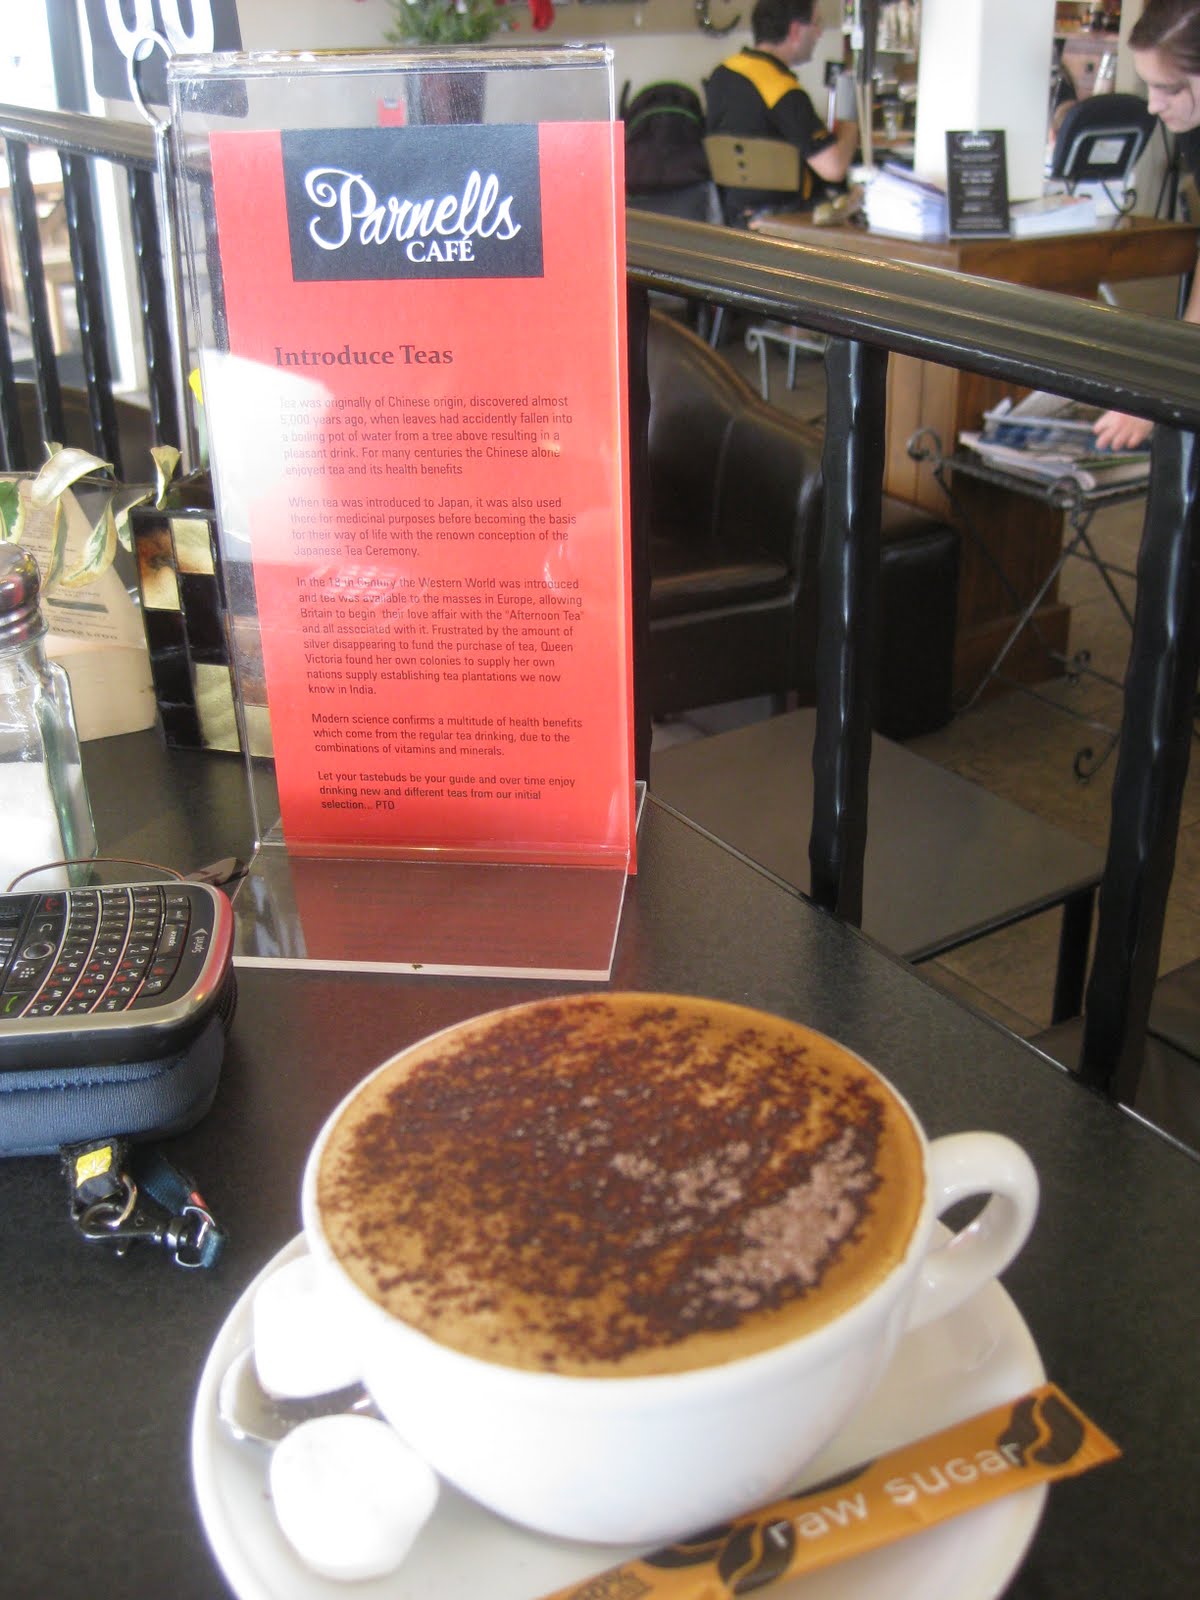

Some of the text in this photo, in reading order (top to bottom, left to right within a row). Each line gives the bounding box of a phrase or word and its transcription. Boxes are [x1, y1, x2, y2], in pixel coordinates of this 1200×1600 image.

[304, 167, 521, 250] Parnells
[406, 235, 475, 263] CAFÉ
[275, 345, 453, 366] Introduce Teas
[388, 397, 431, 408] Chinese
[433, 397, 466, 410] origin,
[469, 396, 529, 407] discovered
[531, 396, 569, 407] almost
[344, 416, 367, 427] ago,
[369, 414, 400, 425] when
[402, 414, 437, 425] leaves
[439, 414, 460, 425] had
[520, 414, 549, 424] fallen
[552, 413, 574, 424] into
[328, 431, 537, 444] pot water from tree above resulting
[329, 448, 359, 459] drink.
[361, 448, 379, 458] For
[381, 449, 411, 461] many
[413, 448, 463, 458] centuries
[464, 448, 483, 458] the
[485, 447, 528, 458] Chinese
[327, 464, 464, 475] tea and its health benefits
[340, 498, 364, 507] was
[365, 497, 421, 508] introduced
[437, 497, 473, 510] Japan,
[485, 499, 509, 508] was
[511, 497, 533, 508] also
[536, 497, 563, 508] used
[335, 513, 578, 527] medicinal purposes before becoming the basis
[333, 529, 570, 543] way life with the renown conception the
[344, 545, 364, 556] Tea
[365, 546, 419, 558] Ceremony.
[399, 578, 416, 588] the
[417, 578, 462, 589] Western
[464, 578, 496, 589] World
[498, 580, 521, 589] was
[298, 592, 317, 603] and
[422, 594, 440, 604] the
[442, 595, 482, 605] masses
[496, 594, 536, 607] Europe,
[538, 595, 584, 608] allowing
[300, 608, 333, 619] Britain
[348, 608, 376, 621] begin
[381, 609, 404, 619] their
[407, 609, 429, 620] love
[431, 609, 458, 620] affair
[459, 610, 483, 620] with
[485, 610, 503, 620] the
[302, 624, 561, 636] and all associated with it. Frustrated the amount
[303, 639, 574, 654] silver disappearing fund the purchase tea, Queen
[304, 654, 556, 669] Victoria found her own colonies supply her own
[306, 669, 562, 684] nations supply establishing tea plantations now
[308, 684, 378, 695] know India.
[311, 713, 584, 728] Modern science confirms multitude health benefits
[313, 728, 571, 744] which come from the regular tea drinking, due the
[314, 742, 506, 756] combinations vitamins and minerals.
[317, 771, 577, 789] Let your tastebuds your guide and over time enjoy
[319, 785, 542, 800] drinking new and different teas from our initial
[375, 800, 396, 811] PTO
[168, 930, 177, 947] space
[192, 934, 204, 954] Sprint
[768, 1491, 869, 1548] raw
